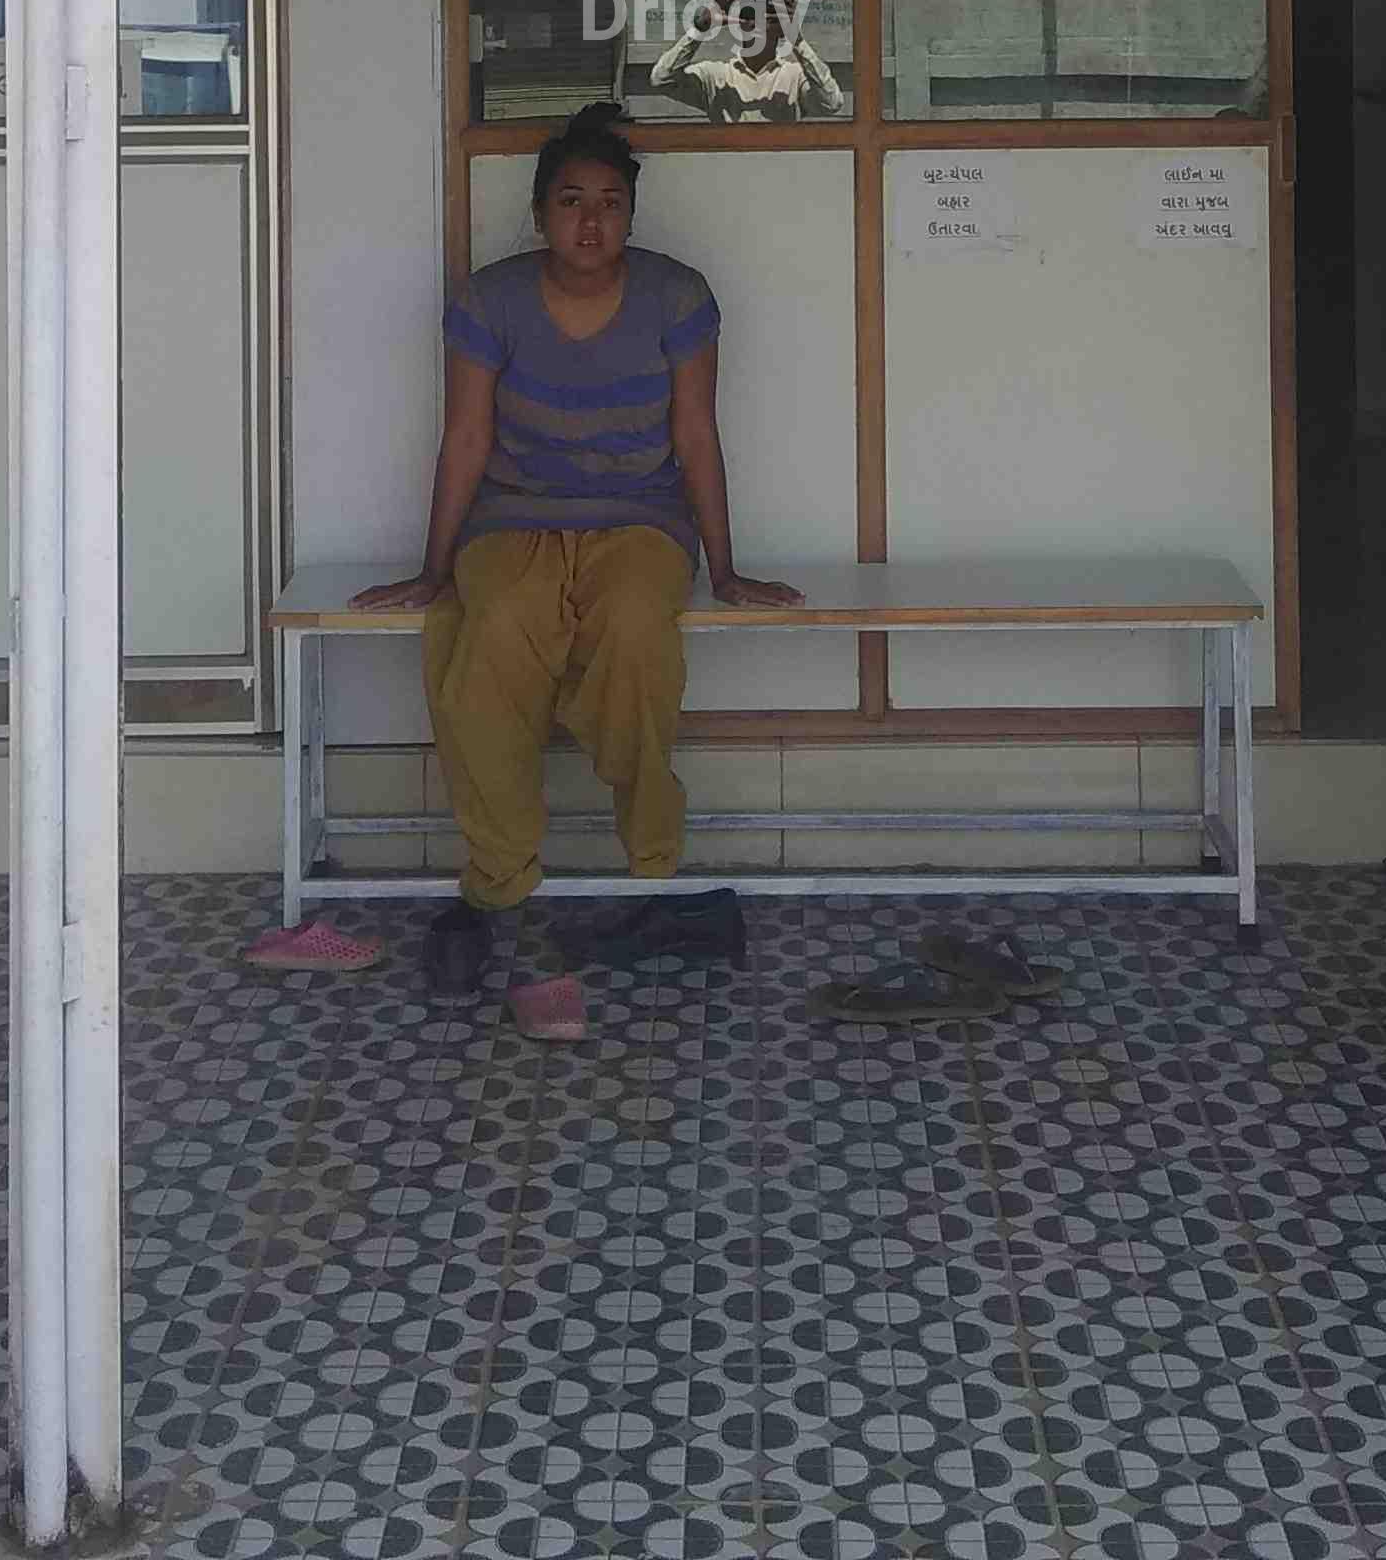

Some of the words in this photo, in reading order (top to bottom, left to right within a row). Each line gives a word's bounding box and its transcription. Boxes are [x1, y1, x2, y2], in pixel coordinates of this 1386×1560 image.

[937, 195, 971, 209] બહાર
[1161, 196, 1188, 208] વારા
[1196, 196, 1229, 211] મુજબ
[928, 221, 977, 236] ઉતારવા
[1155, 220, 1186, 235] અંદર
